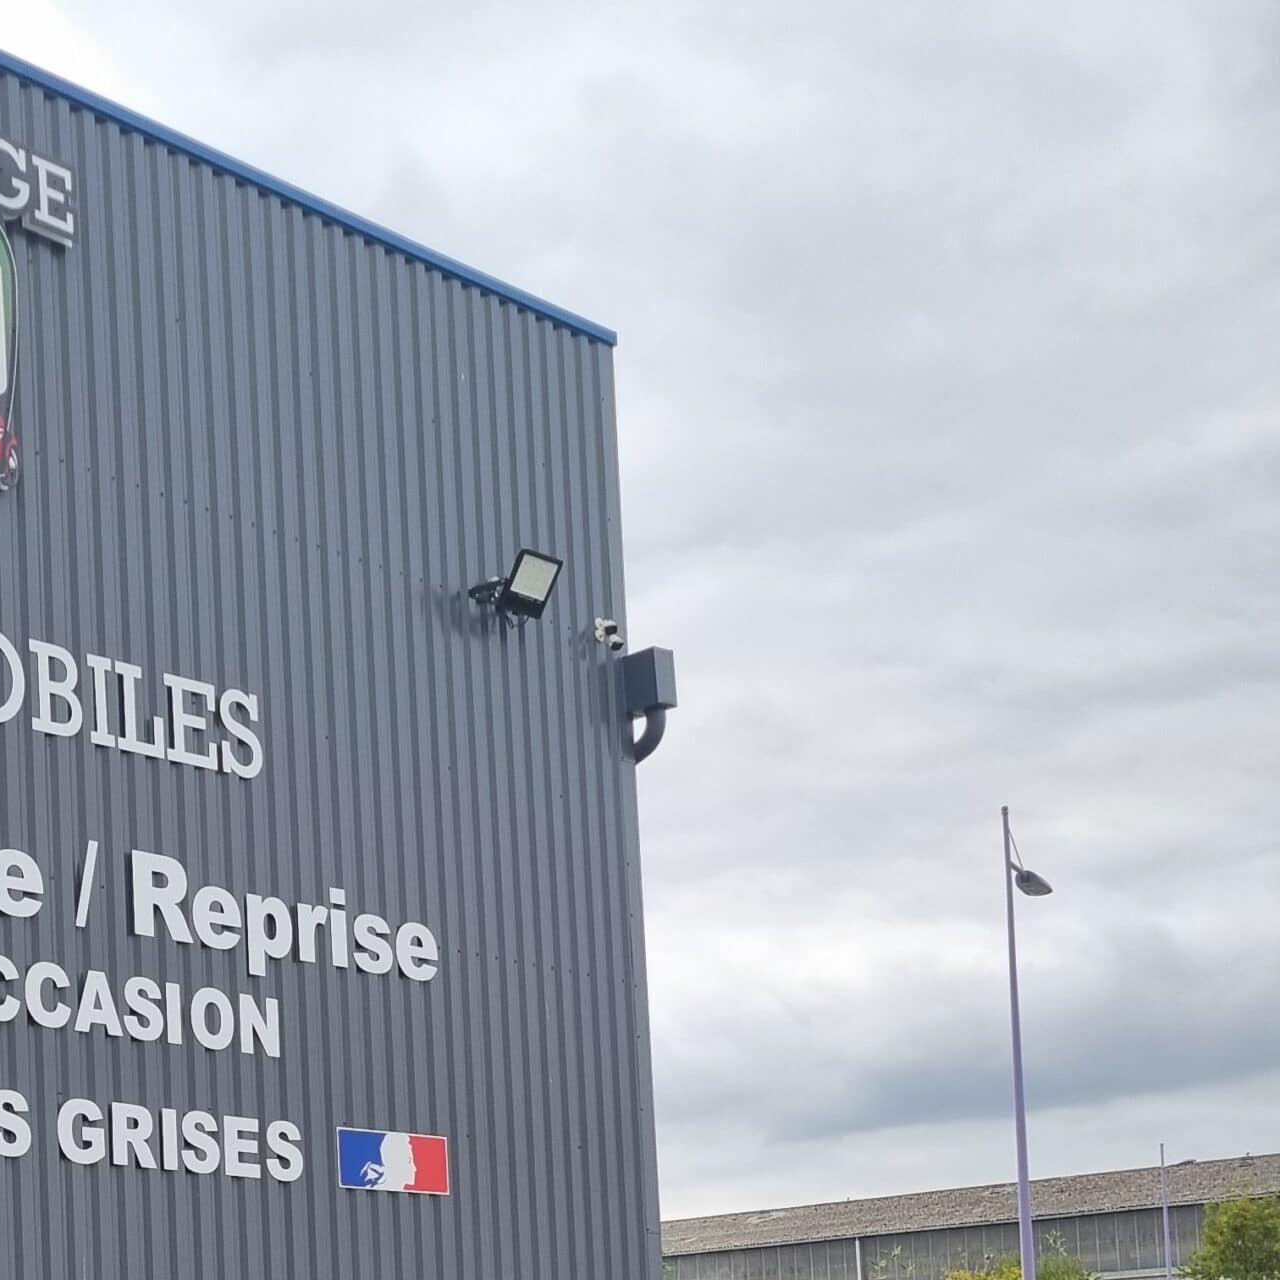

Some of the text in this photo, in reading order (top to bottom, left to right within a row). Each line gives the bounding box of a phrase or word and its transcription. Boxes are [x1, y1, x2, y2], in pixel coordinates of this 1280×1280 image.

[75, 839, 99, 928] /
[131, 849, 439, 982] Reprise
[57, 1098, 304, 1182] GRISES
